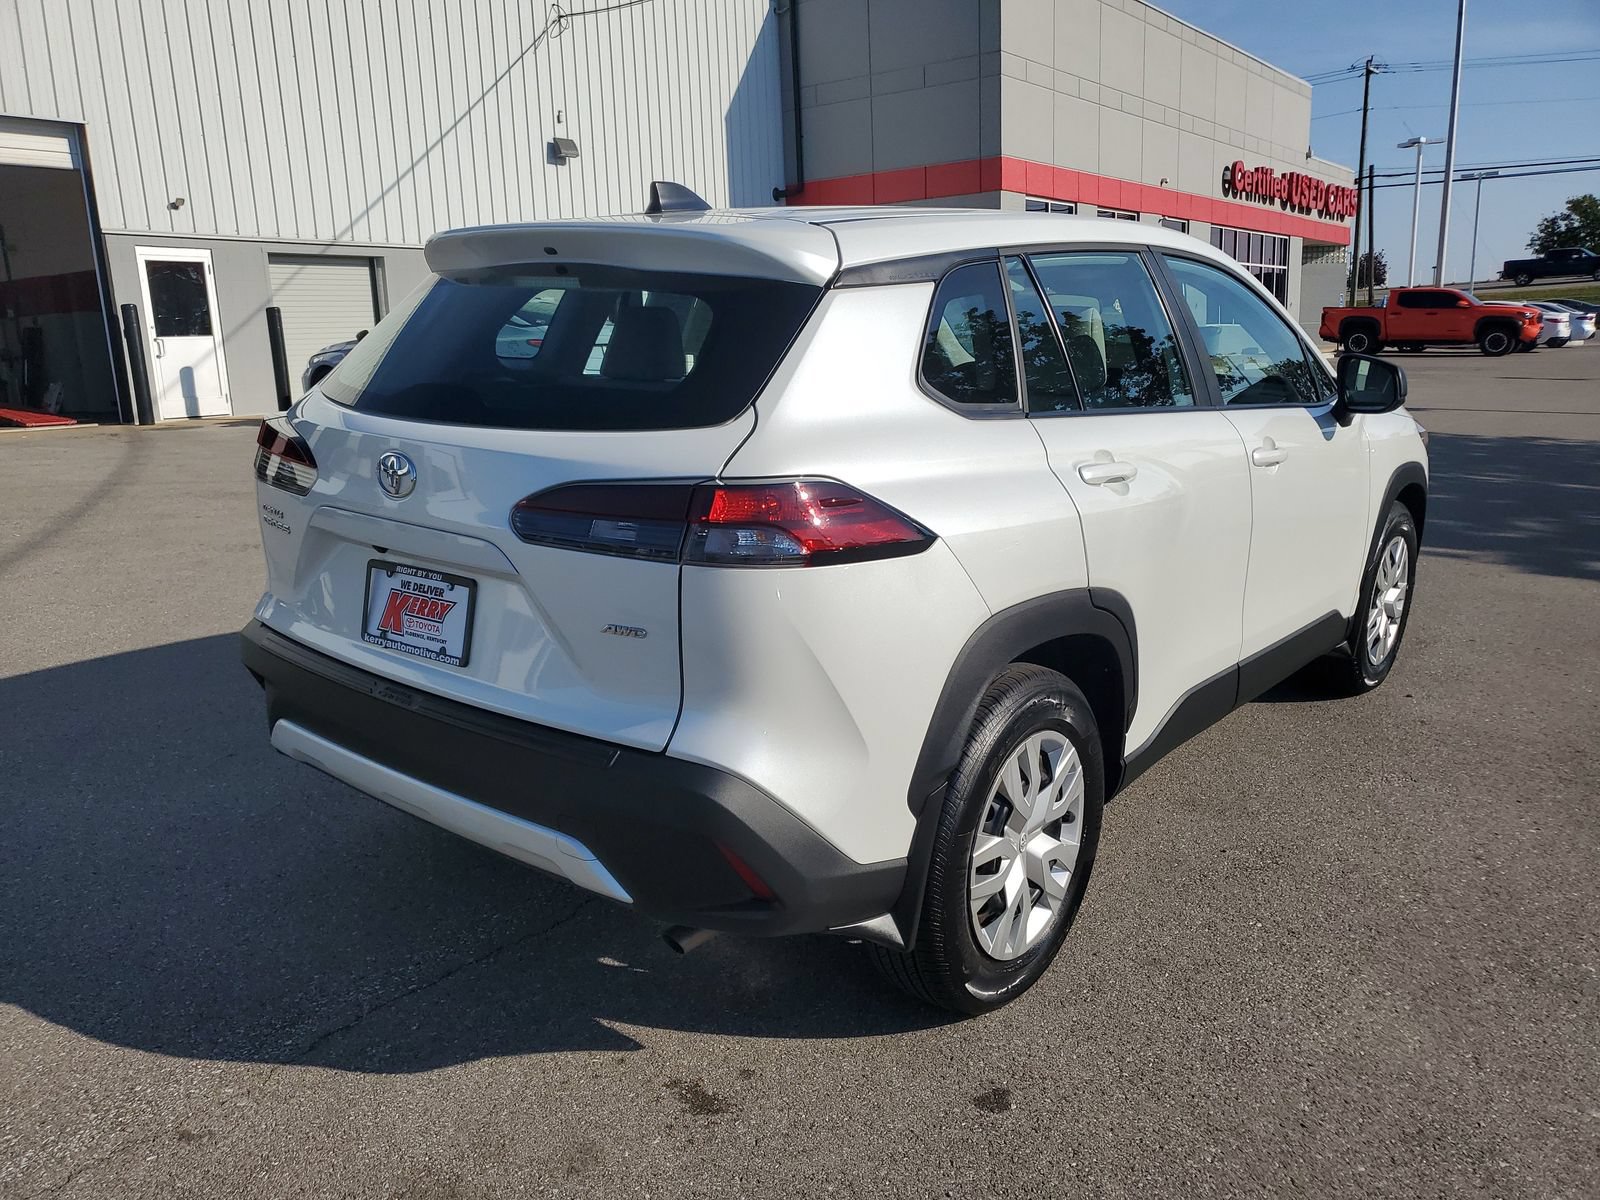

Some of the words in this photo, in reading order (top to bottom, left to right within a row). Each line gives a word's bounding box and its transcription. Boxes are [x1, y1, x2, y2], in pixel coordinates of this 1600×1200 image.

[1231, 160, 1289, 201] Certified
[1290, 171, 1326, 210] USED
[1325, 183, 1358, 217] CARS
[395, 565, 418, 577] RIGHT
[417, 570, 428, 578] BY
[428, 572, 443, 581] YOU
[401, 579, 412, 591] WE
[412, 582, 446, 598] DELIVER
[415, 620, 441, 634] TOYOTA
[600, 623, 648, 640] AWD
[364, 632, 460, 666] kerryautomotive.com
